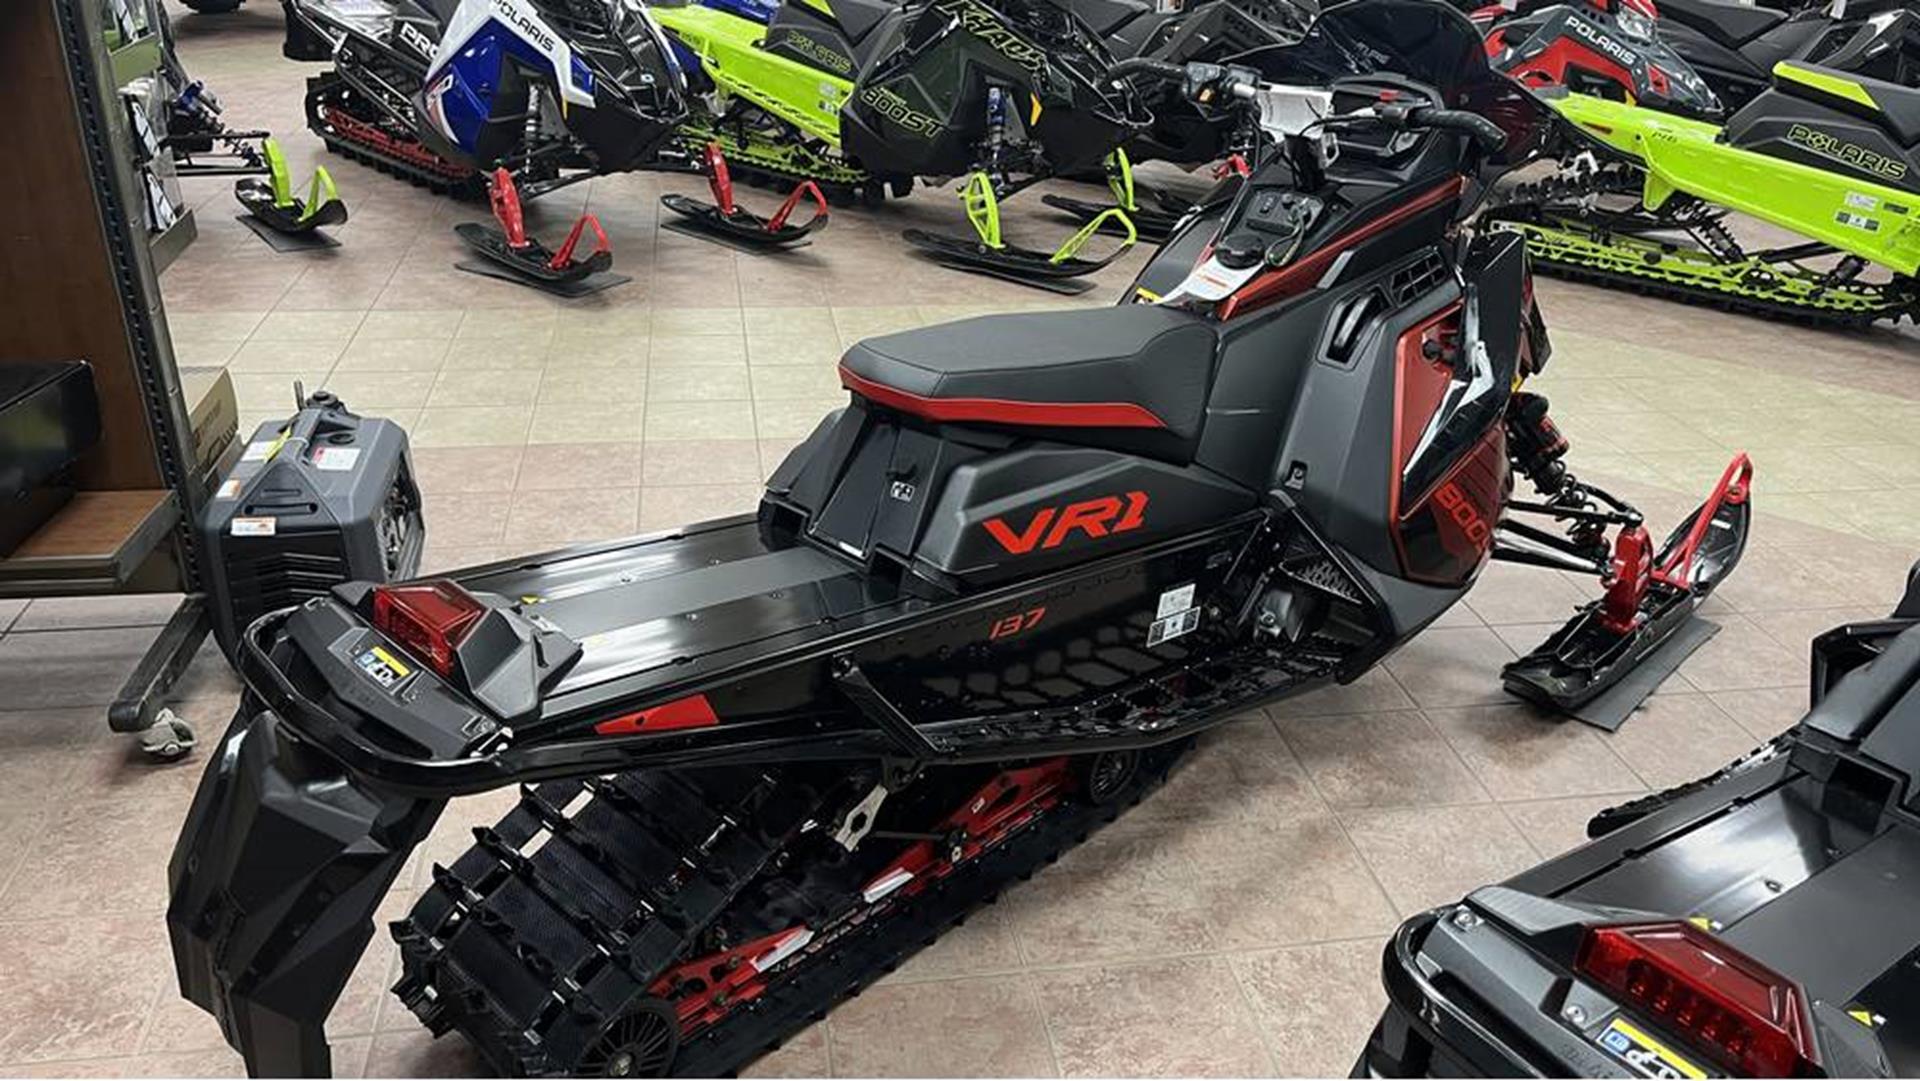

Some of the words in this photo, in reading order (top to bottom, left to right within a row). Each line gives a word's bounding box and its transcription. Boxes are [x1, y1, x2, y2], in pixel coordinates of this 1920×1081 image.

[1565, 16, 1637, 66] POLARIS
[860, 86, 945, 138] BOOST
[1786, 124, 1908, 180] POLARIS
[982, 490, 1149, 554] VR1
[988, 606, 1046, 640] 137
